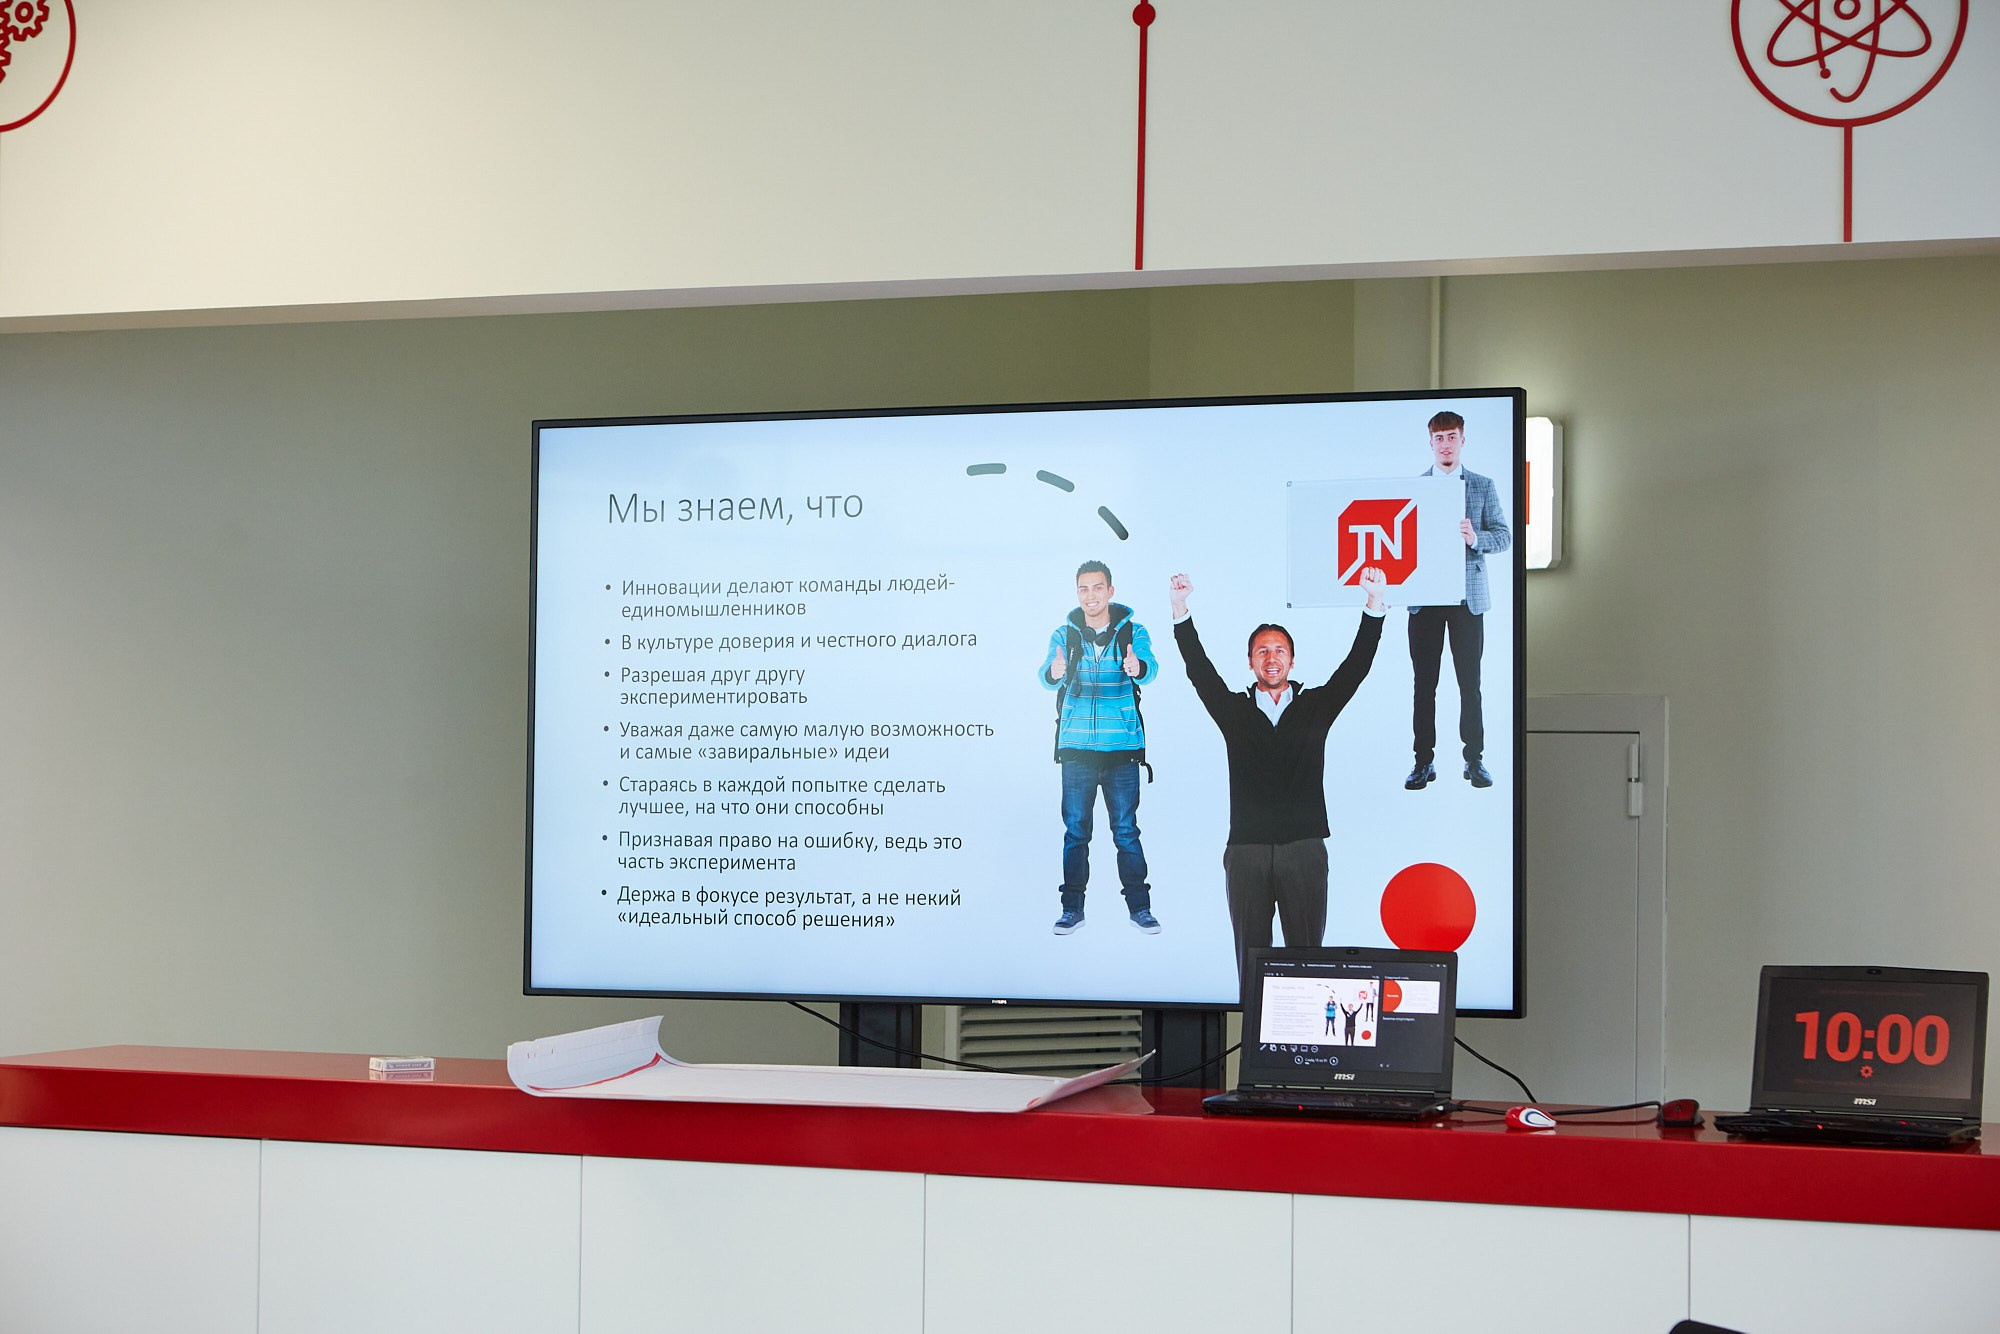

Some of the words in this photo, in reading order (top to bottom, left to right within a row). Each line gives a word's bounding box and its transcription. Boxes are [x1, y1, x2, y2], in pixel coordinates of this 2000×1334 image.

[608, 492, 665, 524] Мы
[677, 496, 793, 526] знаем,
[806, 494, 863, 519] что
[622, 579, 722, 599] Инновации
[726, 580, 794, 598] делают
[799, 579, 882, 596] команды
[886, 573, 956, 595] людей-
[621, 602, 807, 622] единомышленников
[621, 634, 632, 651] В
[637, 636, 714, 655] культуре
[718, 636, 795, 653] доверия
[800, 635, 811, 649] и
[816, 634, 897, 648] честного
[901, 633, 977, 651] диалога
[621, 666, 706, 687] Разрешая
[710, 669, 752, 687] друг
[754, 668, 806, 686] другу
[619, 691, 808, 709] экспериментировать
[619, 721, 683, 738] Уважая
[687, 724, 735, 741] даже
[739, 724, 798, 742] самую
[803, 724, 865, 742] малую
[870, 723, 995, 737] возможность
[620, 746, 630, 760] и
[635, 746, 693, 760] самые
[697, 746, 839, 764] «завиральные»
[844, 746, 889, 764] идеи
[619, 775, 698, 797] Стараясь
[703, 779, 713, 793] в
[717, 775, 786, 797] каждой
[791, 779, 868, 793] попытке
[873, 780, 946, 797] сделать
[617, 801, 690, 819] лучшее,
[695, 801, 716, 815] на
[720, 802, 750, 815] что
[755, 802, 789, 815] они
[794, 797, 884, 816] способны
[619, 830, 713, 852] Признавая
[719, 835, 772, 853] право
[777, 835, 798, 849] на
[803, 830, 879, 854] ошибку,
[884, 836, 928, 854] ведь
[932, 836, 963, 850] это
[617, 856, 665, 870] часть
[668, 856, 796, 875] эксперимента
[616, 885, 676, 907] Держа
[681, 889, 691, 903] в
[695, 884, 760, 908] фокусе
[764, 890, 856, 909] результат,
[861, 892, 871, 906] а
[877, 892, 900, 906] не
[905, 888, 961, 907] некий
[617, 907, 728, 928] «идеальный
[733, 908, 797, 927] способ
[802, 913, 895, 931] решения»
[1795, 1010, 1950, 1065] 10:00
